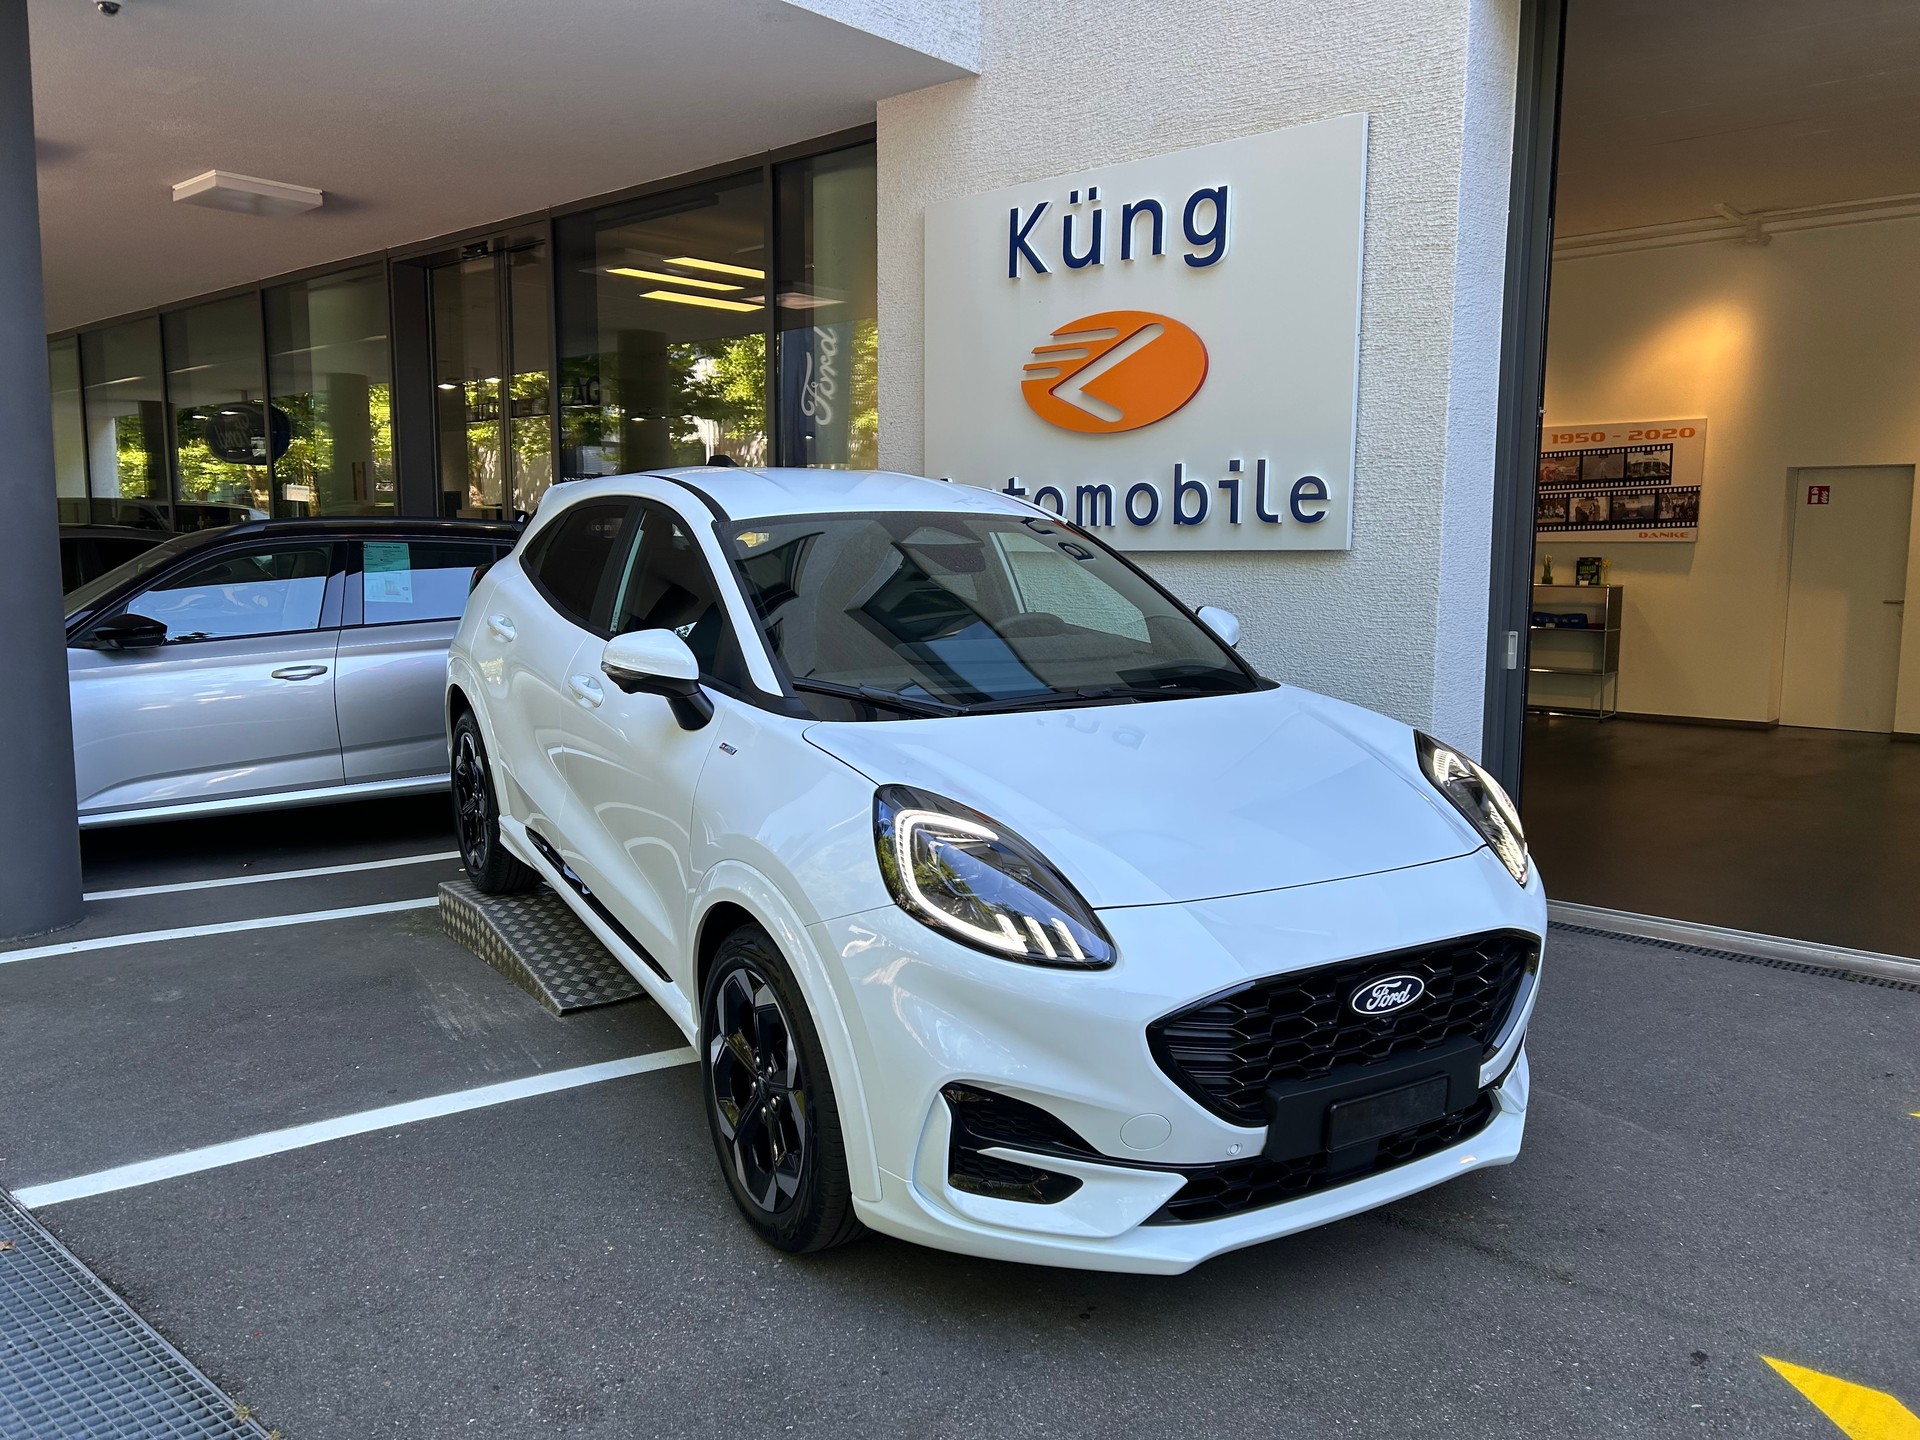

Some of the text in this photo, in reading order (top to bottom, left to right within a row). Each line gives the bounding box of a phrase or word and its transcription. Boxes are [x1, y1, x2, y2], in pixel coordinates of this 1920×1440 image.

[1009, 185, 1229, 279] Küng
[801, 326, 839, 426] Ford
[1552, 432, 1606, 444] 1950
[1628, 427, 1696, 441] 2020
[1638, 531, 1689, 539] DANKE
[1366, 981, 1412, 1010] Ford
